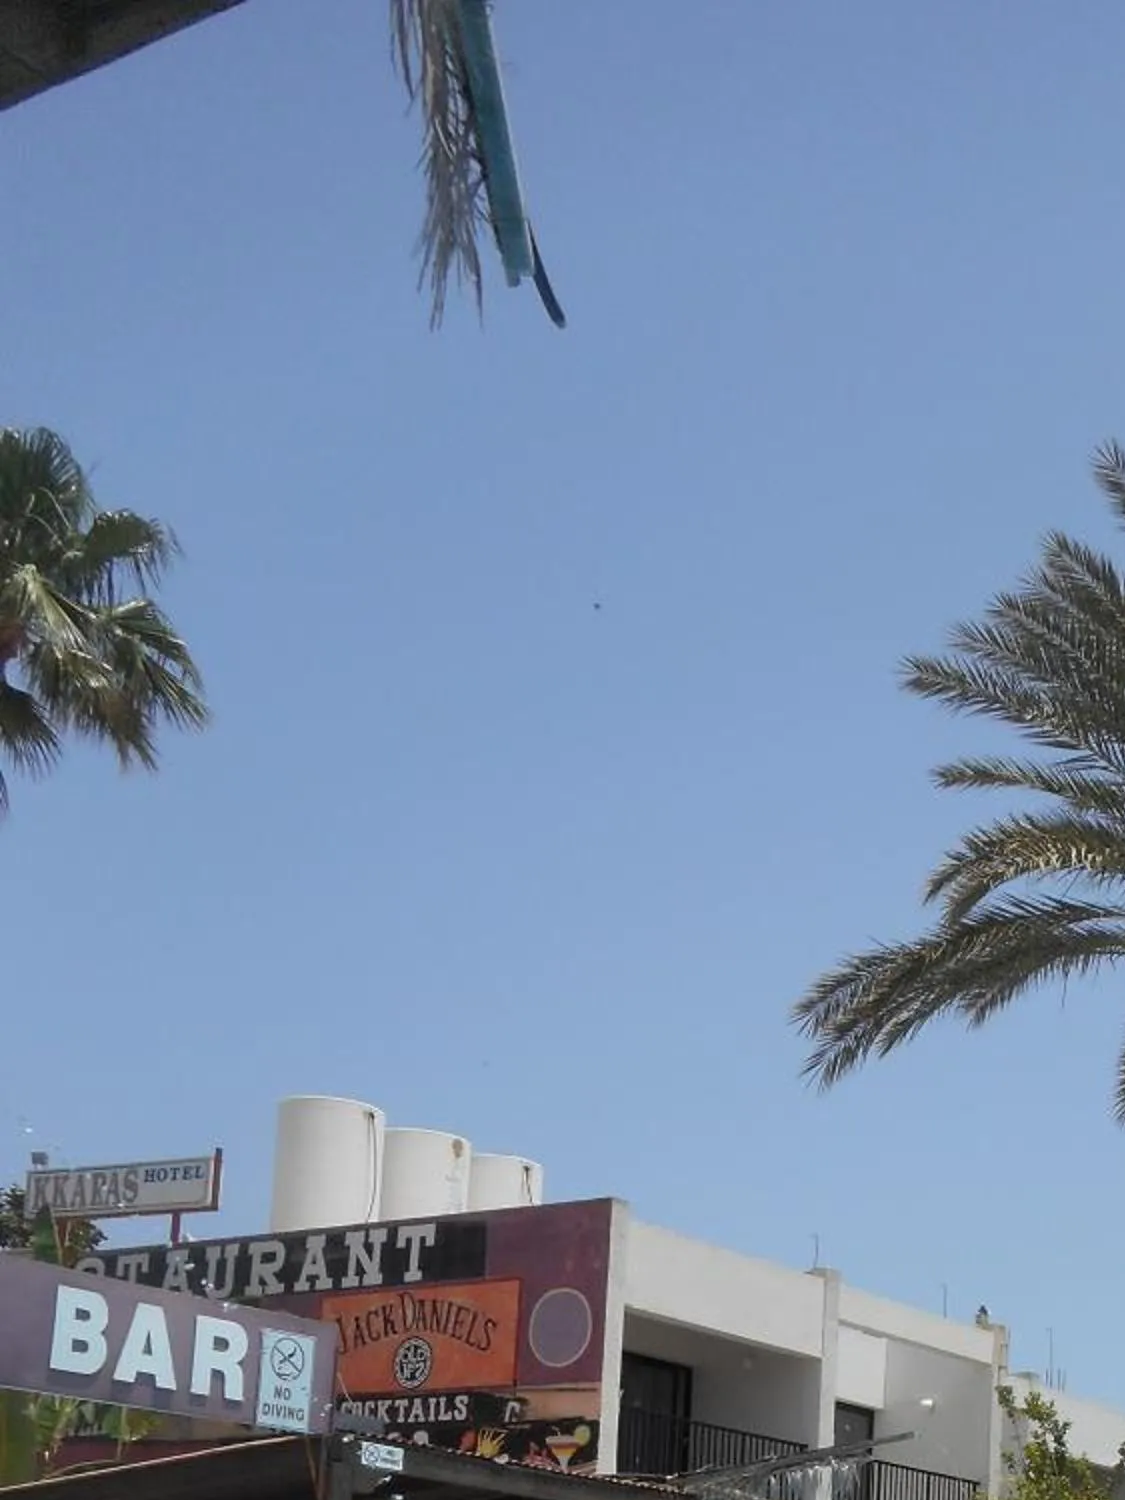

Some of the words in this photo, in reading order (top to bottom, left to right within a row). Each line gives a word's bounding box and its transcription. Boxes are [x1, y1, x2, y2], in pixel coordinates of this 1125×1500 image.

[144, 1165, 204, 1183] HOTEL
[335, 1303, 398, 1353] JACK
[49, 1285, 249, 1401] BAR
[274, 1385, 291, 1401] NO
[262, 1403, 305, 1421] DIVING
[341, 1395, 469, 1424] COCKTAILS
